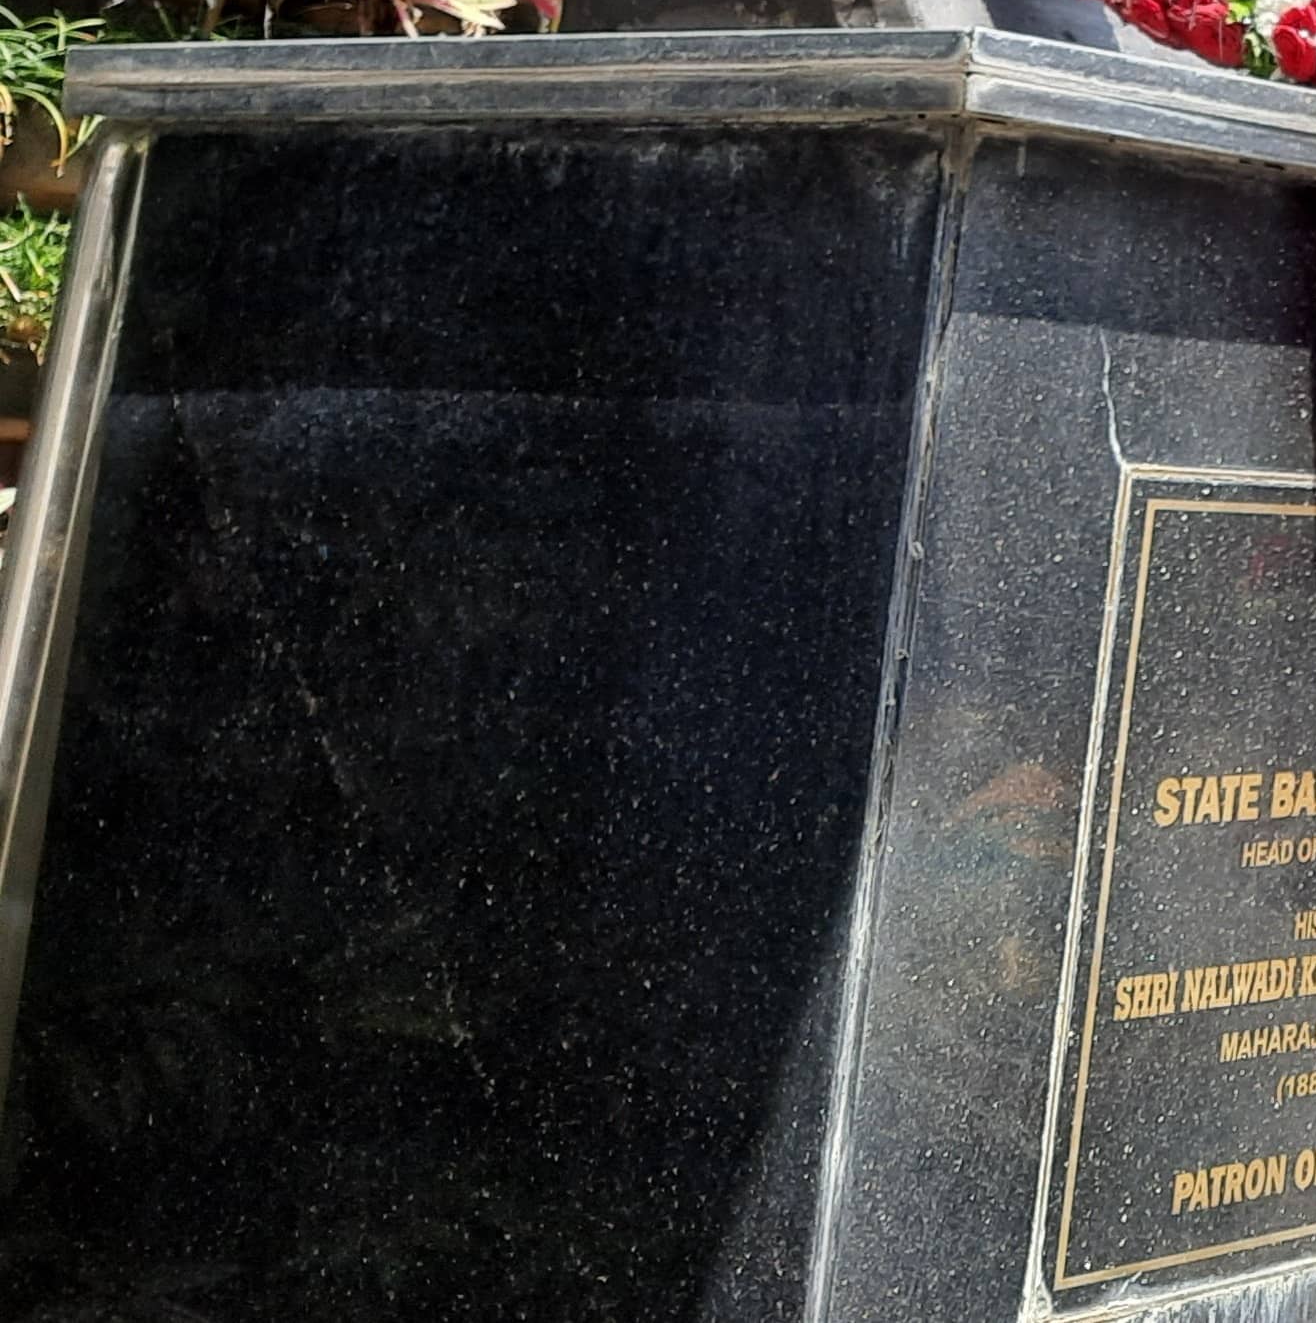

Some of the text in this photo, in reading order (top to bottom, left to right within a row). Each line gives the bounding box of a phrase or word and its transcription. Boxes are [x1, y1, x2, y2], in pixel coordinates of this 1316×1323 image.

[1153, 773, 1262, 827] STATE
[1242, 838, 1294, 868] HEAD
[1113, 971, 1176, 1021] SHRI
[1180, 960, 1295, 1012] NALWADI
[1172, 1156, 1287, 1215] PATRON
